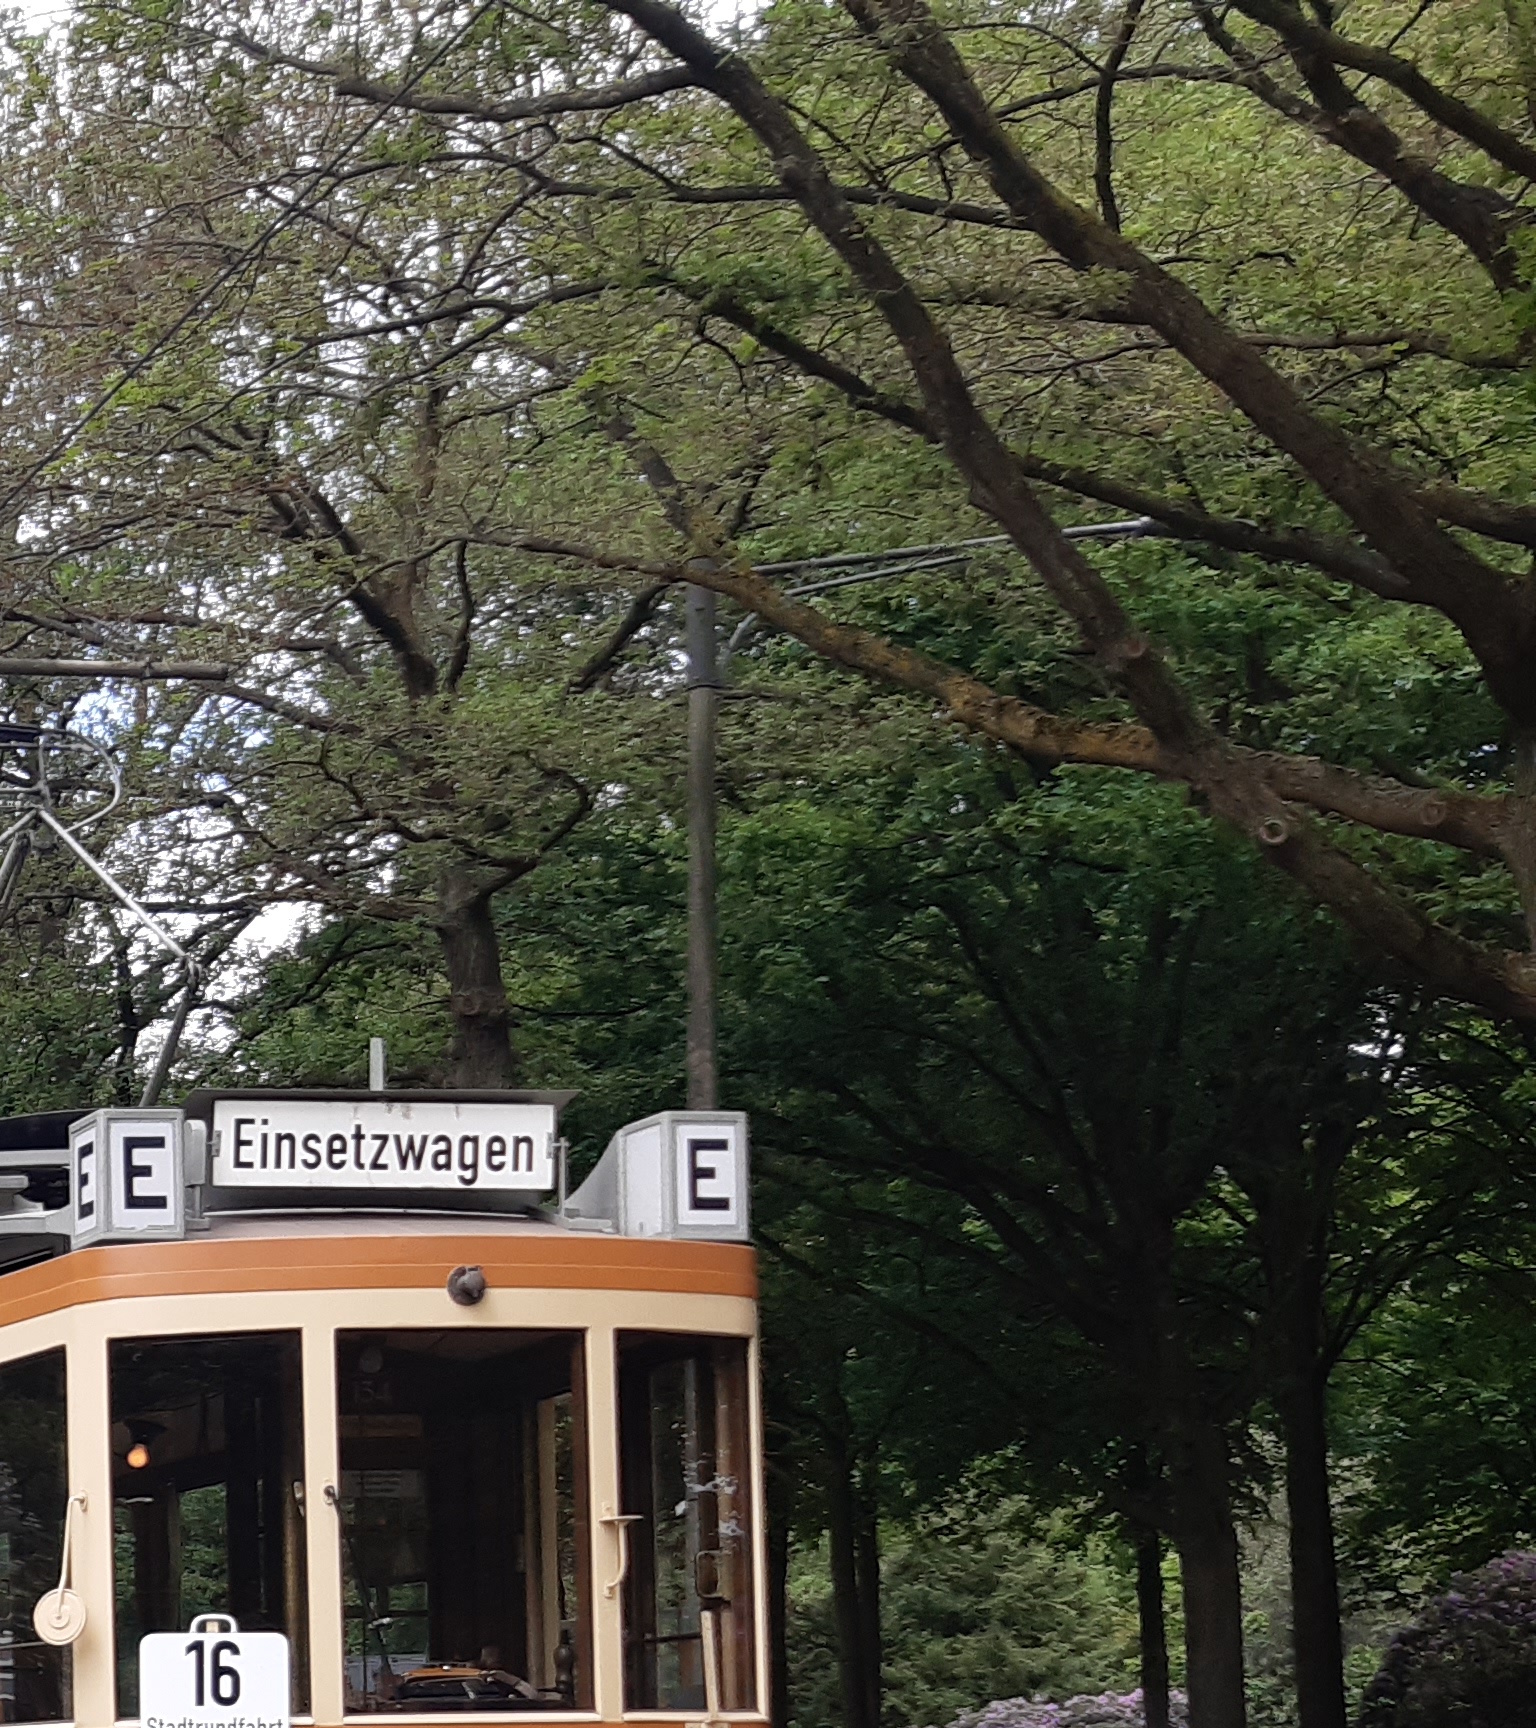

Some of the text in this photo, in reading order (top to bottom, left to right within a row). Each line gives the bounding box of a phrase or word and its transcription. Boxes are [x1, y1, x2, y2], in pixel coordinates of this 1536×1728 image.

[77, 1141, 94, 1219] E
[122, 1135, 168, 1210] E
[232, 1116, 535, 1186] Einsetzwagen
[686, 1138, 731, 1211] E
[184, 1639, 242, 1708] 16
